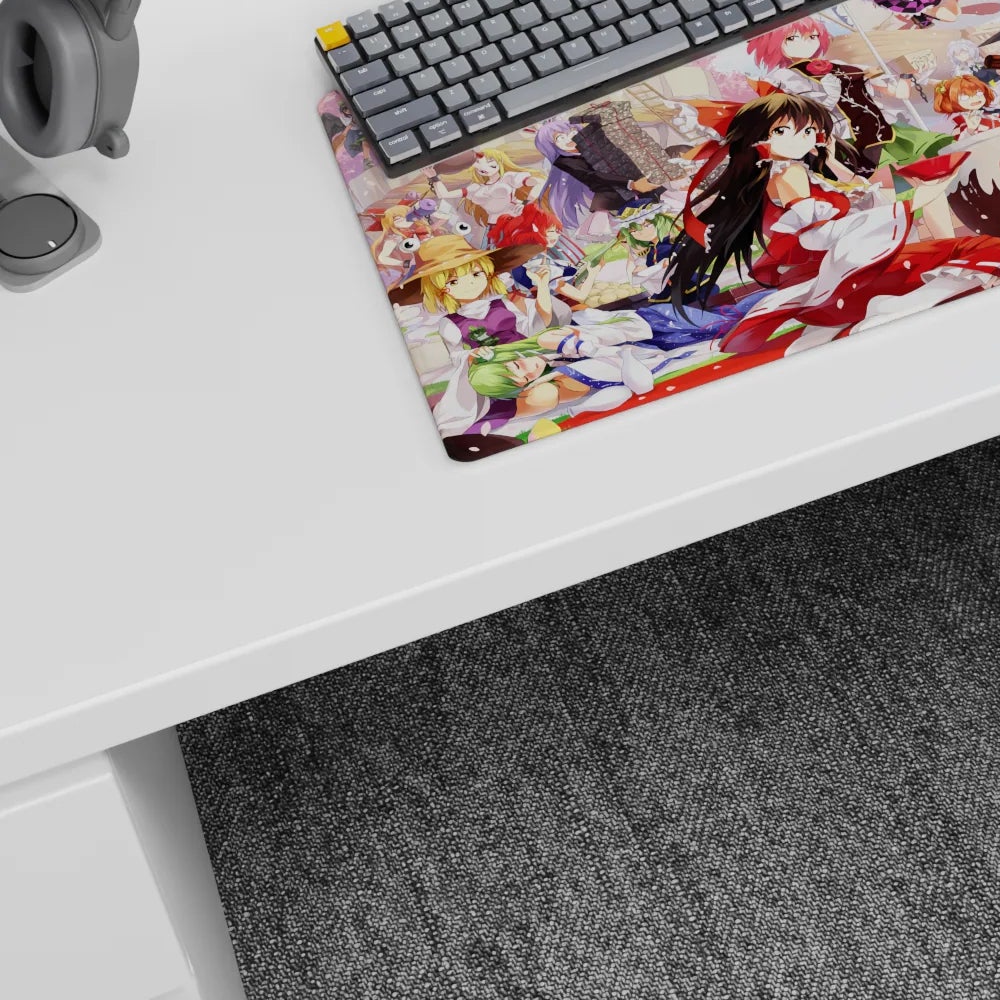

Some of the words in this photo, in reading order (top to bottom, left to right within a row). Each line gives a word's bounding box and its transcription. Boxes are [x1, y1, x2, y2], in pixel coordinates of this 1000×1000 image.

[373, 88, 386, 96] caps
[394, 107, 407, 116] shift
[464, 103, 491, 116] command
[428, 120, 448, 131] option
[388, 135, 408, 146] control
